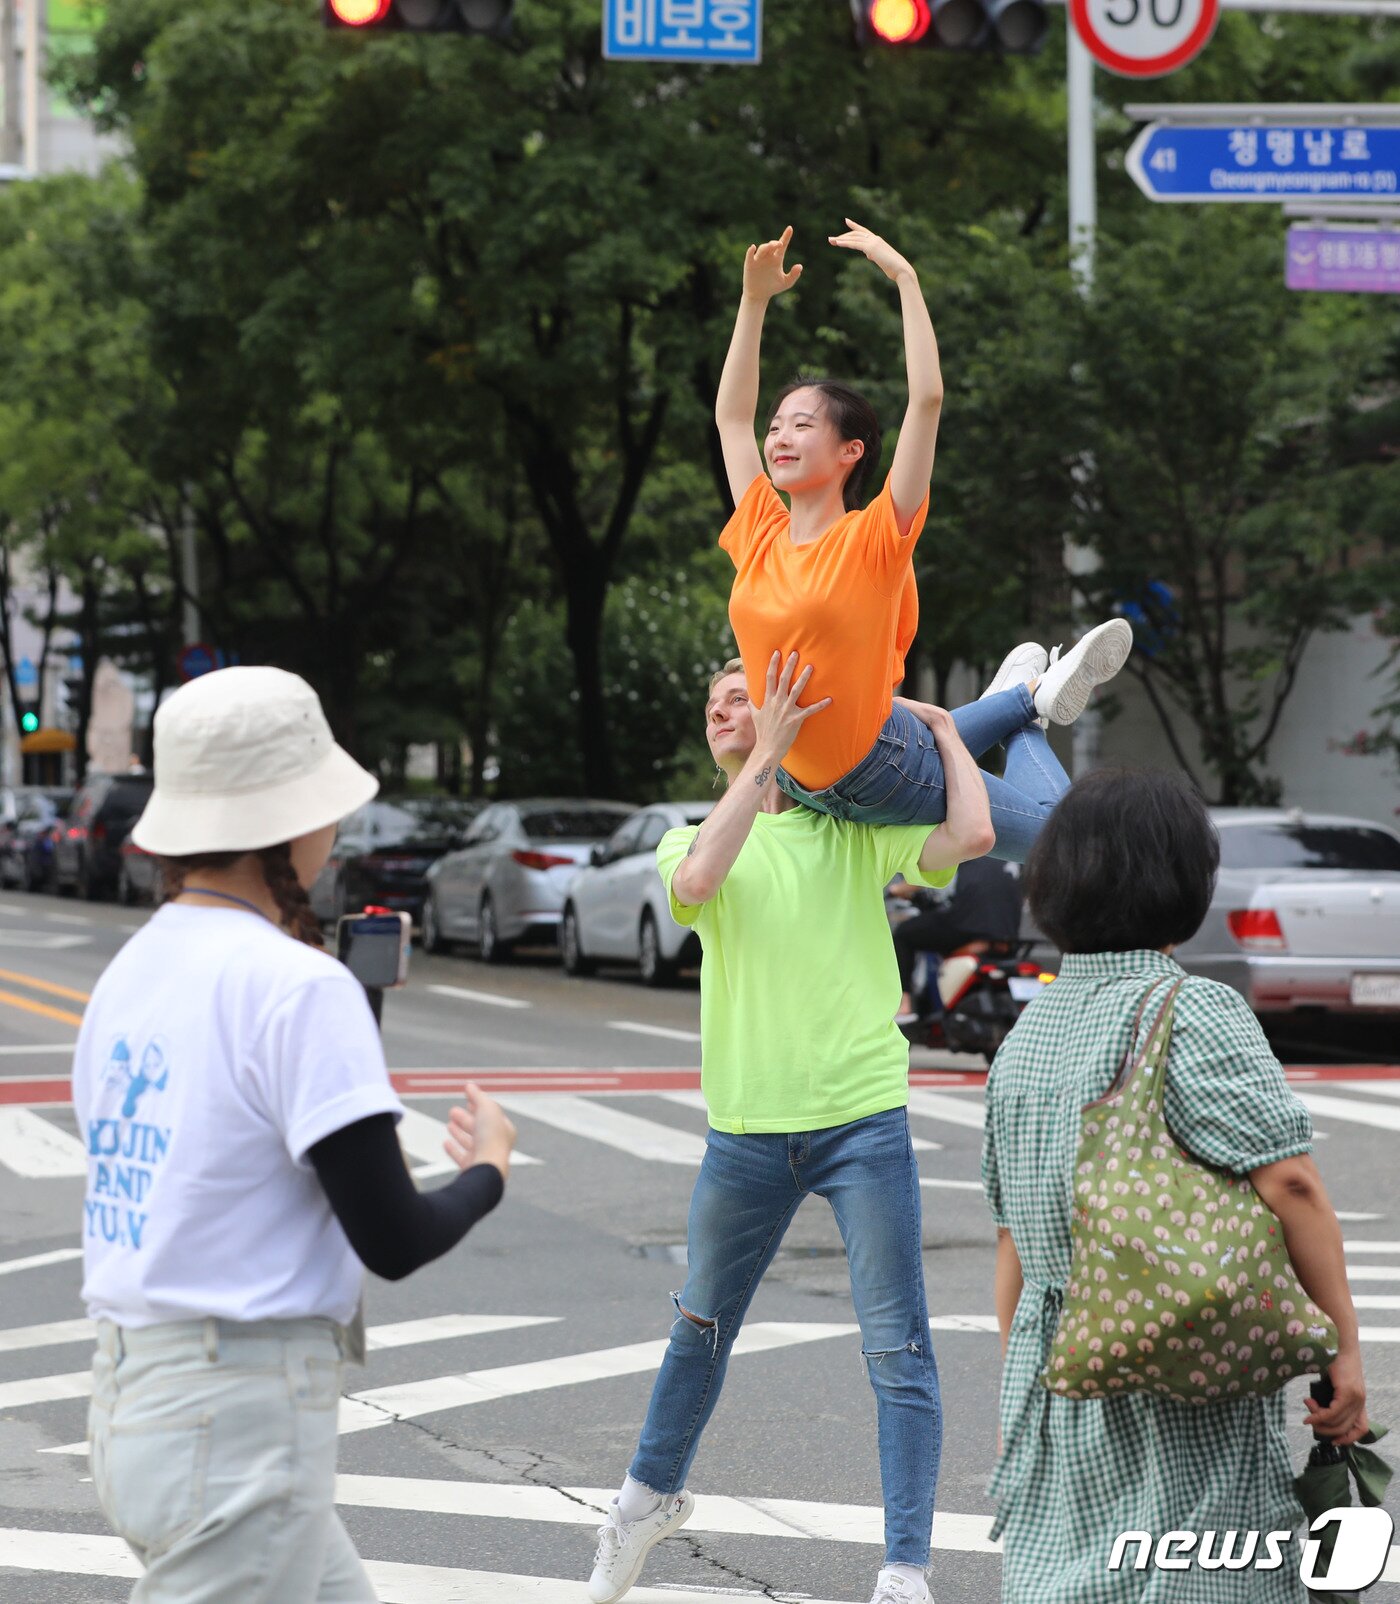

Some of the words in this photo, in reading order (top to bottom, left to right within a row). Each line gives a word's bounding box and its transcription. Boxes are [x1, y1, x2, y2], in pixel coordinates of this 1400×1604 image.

[615, 0, 752, 49] 비보호
[1149, 148, 1177, 173] 41
[1228, 129, 1371, 166] 청명남로
[94, 1161, 152, 1203] AND
